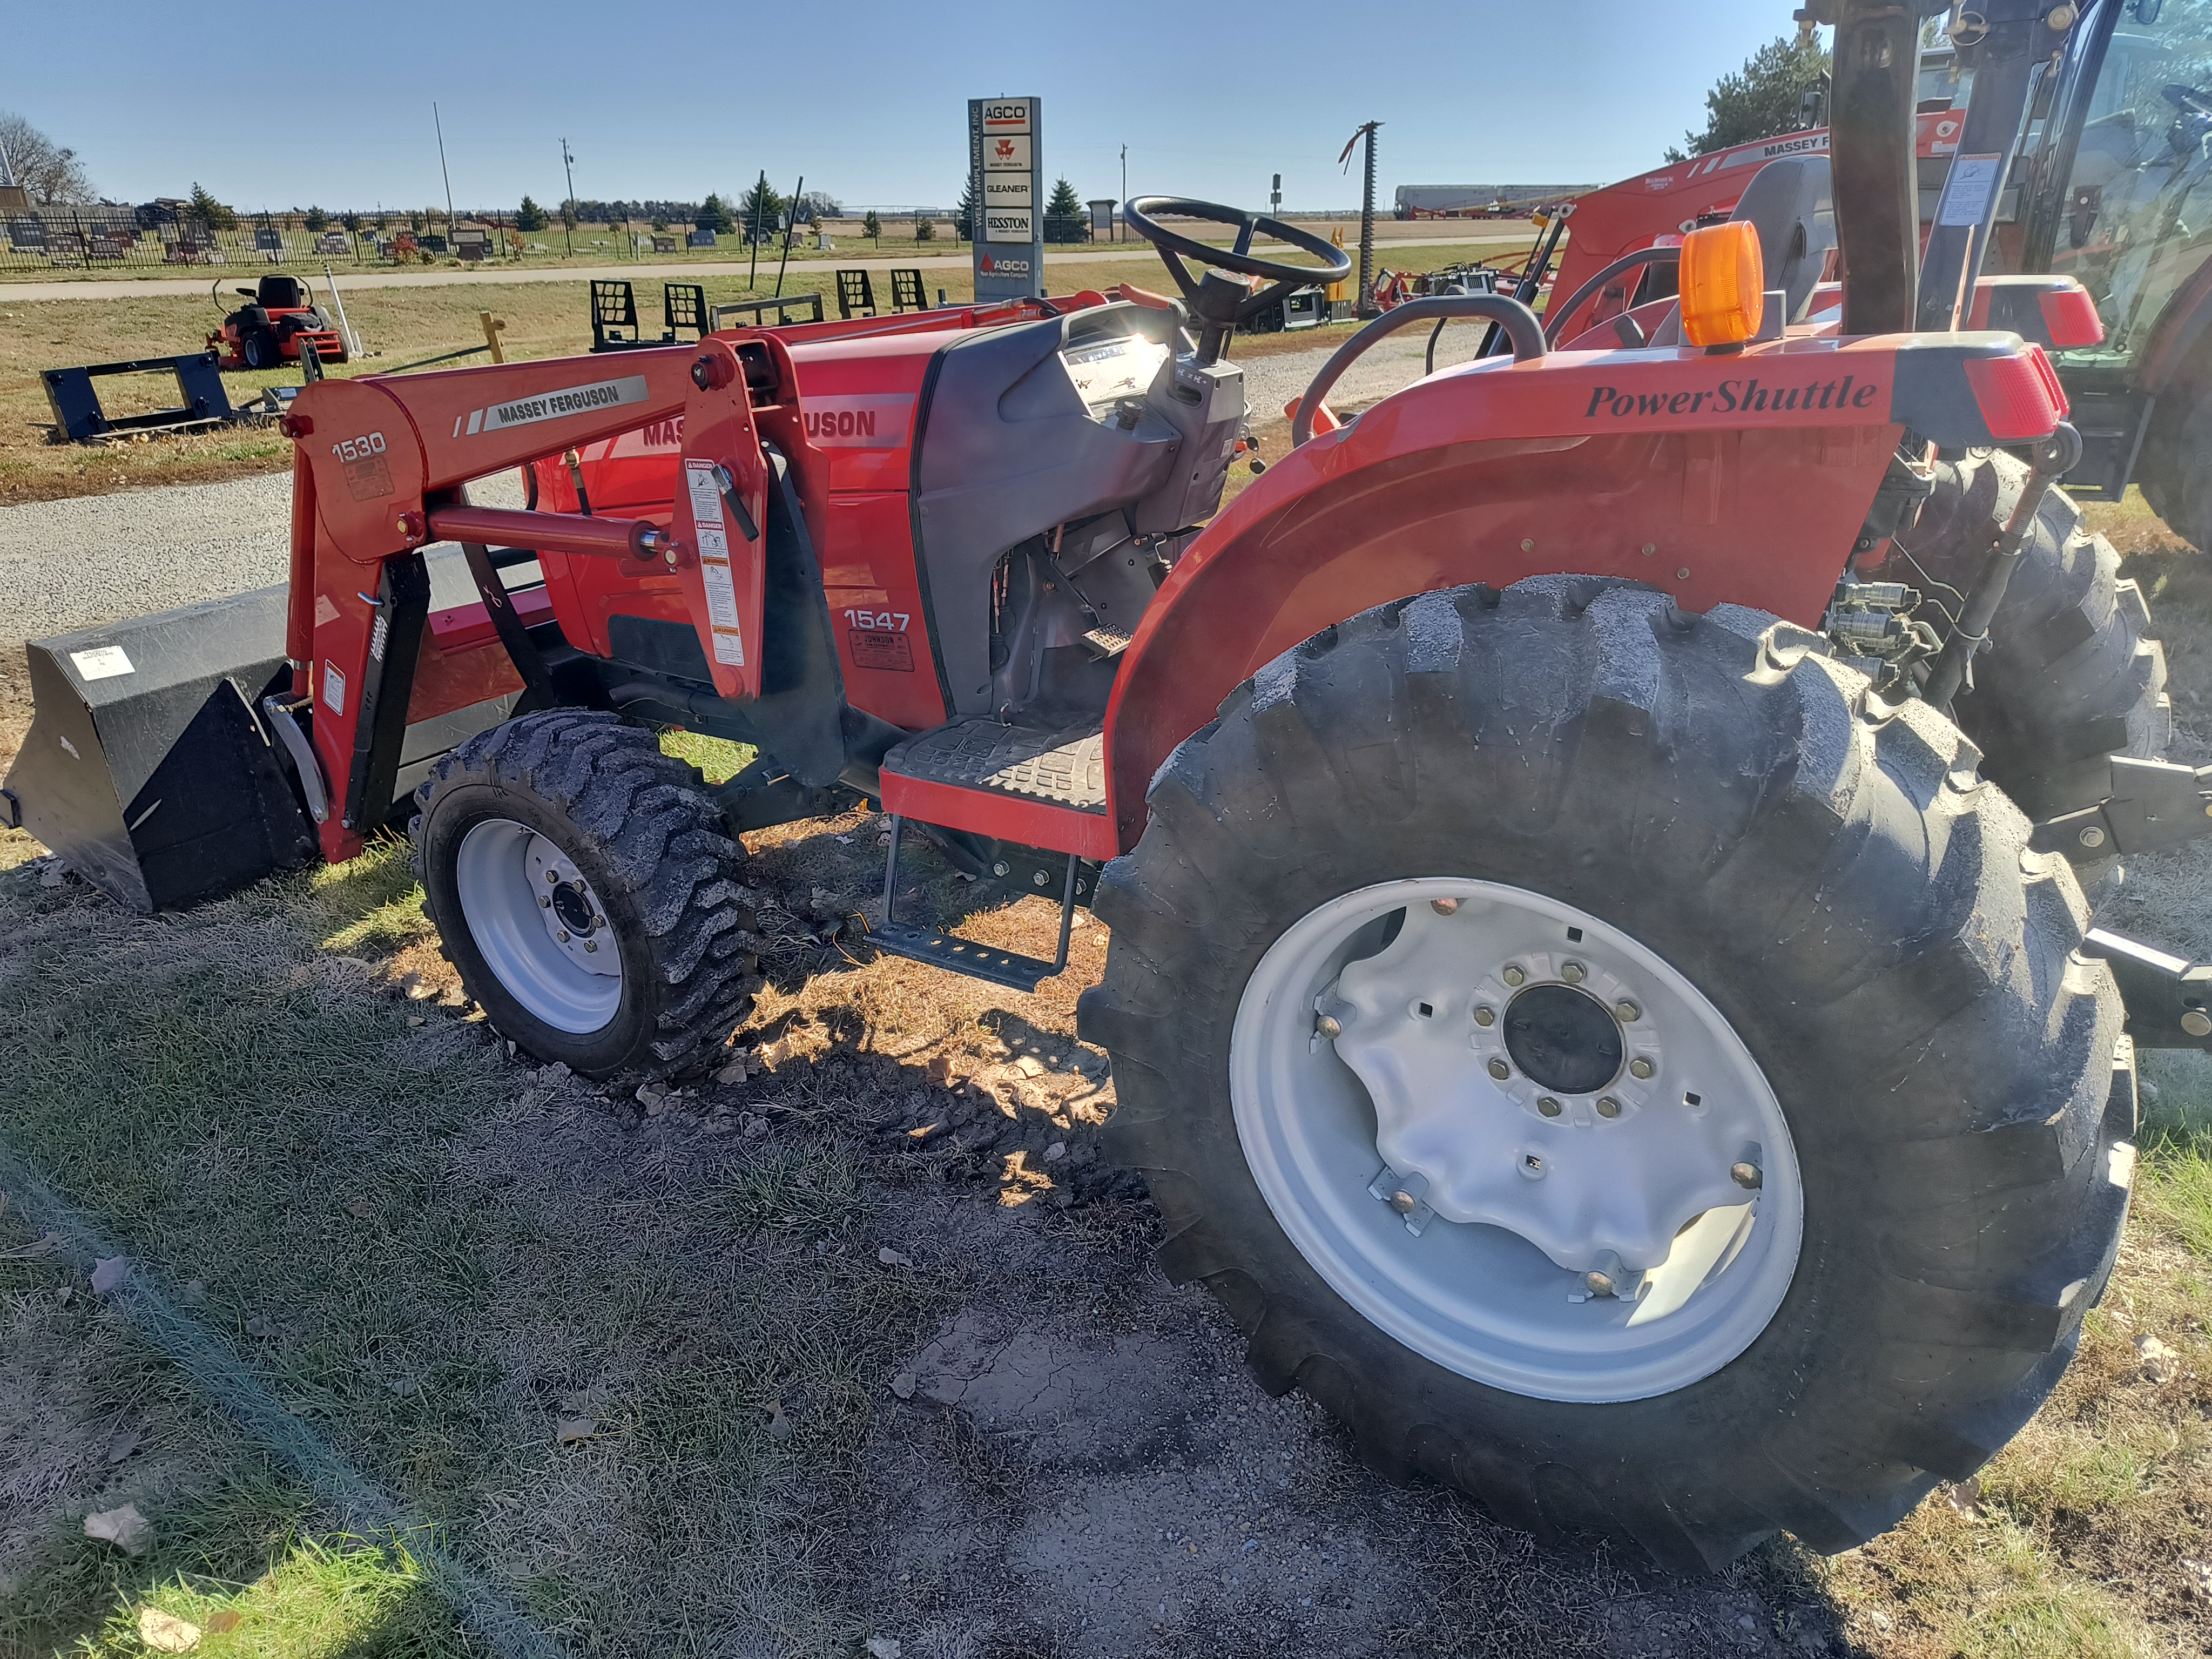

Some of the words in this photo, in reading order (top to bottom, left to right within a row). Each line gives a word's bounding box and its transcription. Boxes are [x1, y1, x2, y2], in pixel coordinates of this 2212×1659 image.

[984, 106, 1025, 119] AGCO
[1764, 138, 1818, 157] MASSEY
[974, 193, 982, 227] WELLS
[988, 218, 1029, 228] HESSTON
[994, 260, 1029, 271] AGCO
[497, 399, 548, 424] MASSEY
[549, 385, 620, 414] FERGUSON
[1583, 375, 1877, 418] PowerShuttle
[332, 431, 387, 463] 1530
[844, 610, 909, 632] 1547
